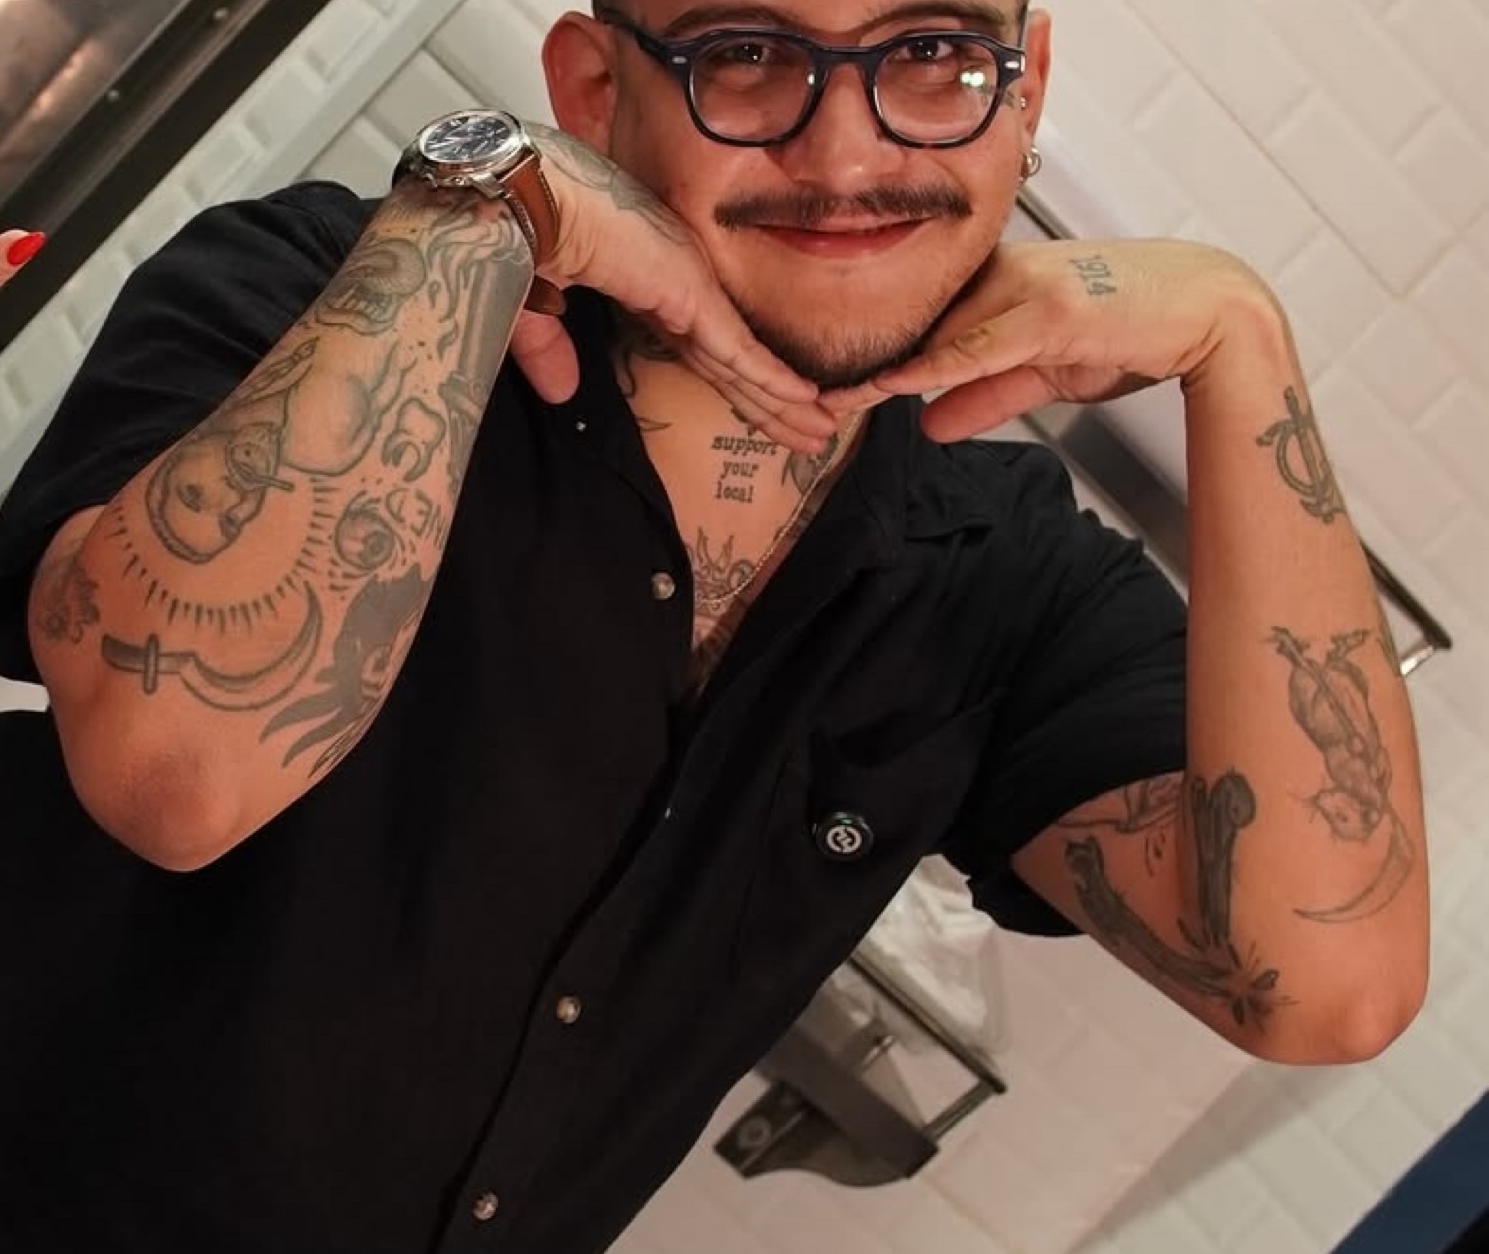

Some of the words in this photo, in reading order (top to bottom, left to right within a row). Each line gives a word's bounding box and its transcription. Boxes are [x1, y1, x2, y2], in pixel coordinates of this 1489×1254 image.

[710, 435, 778, 456] support
[720, 461, 759, 480] your
[714, 481, 754, 503] local
